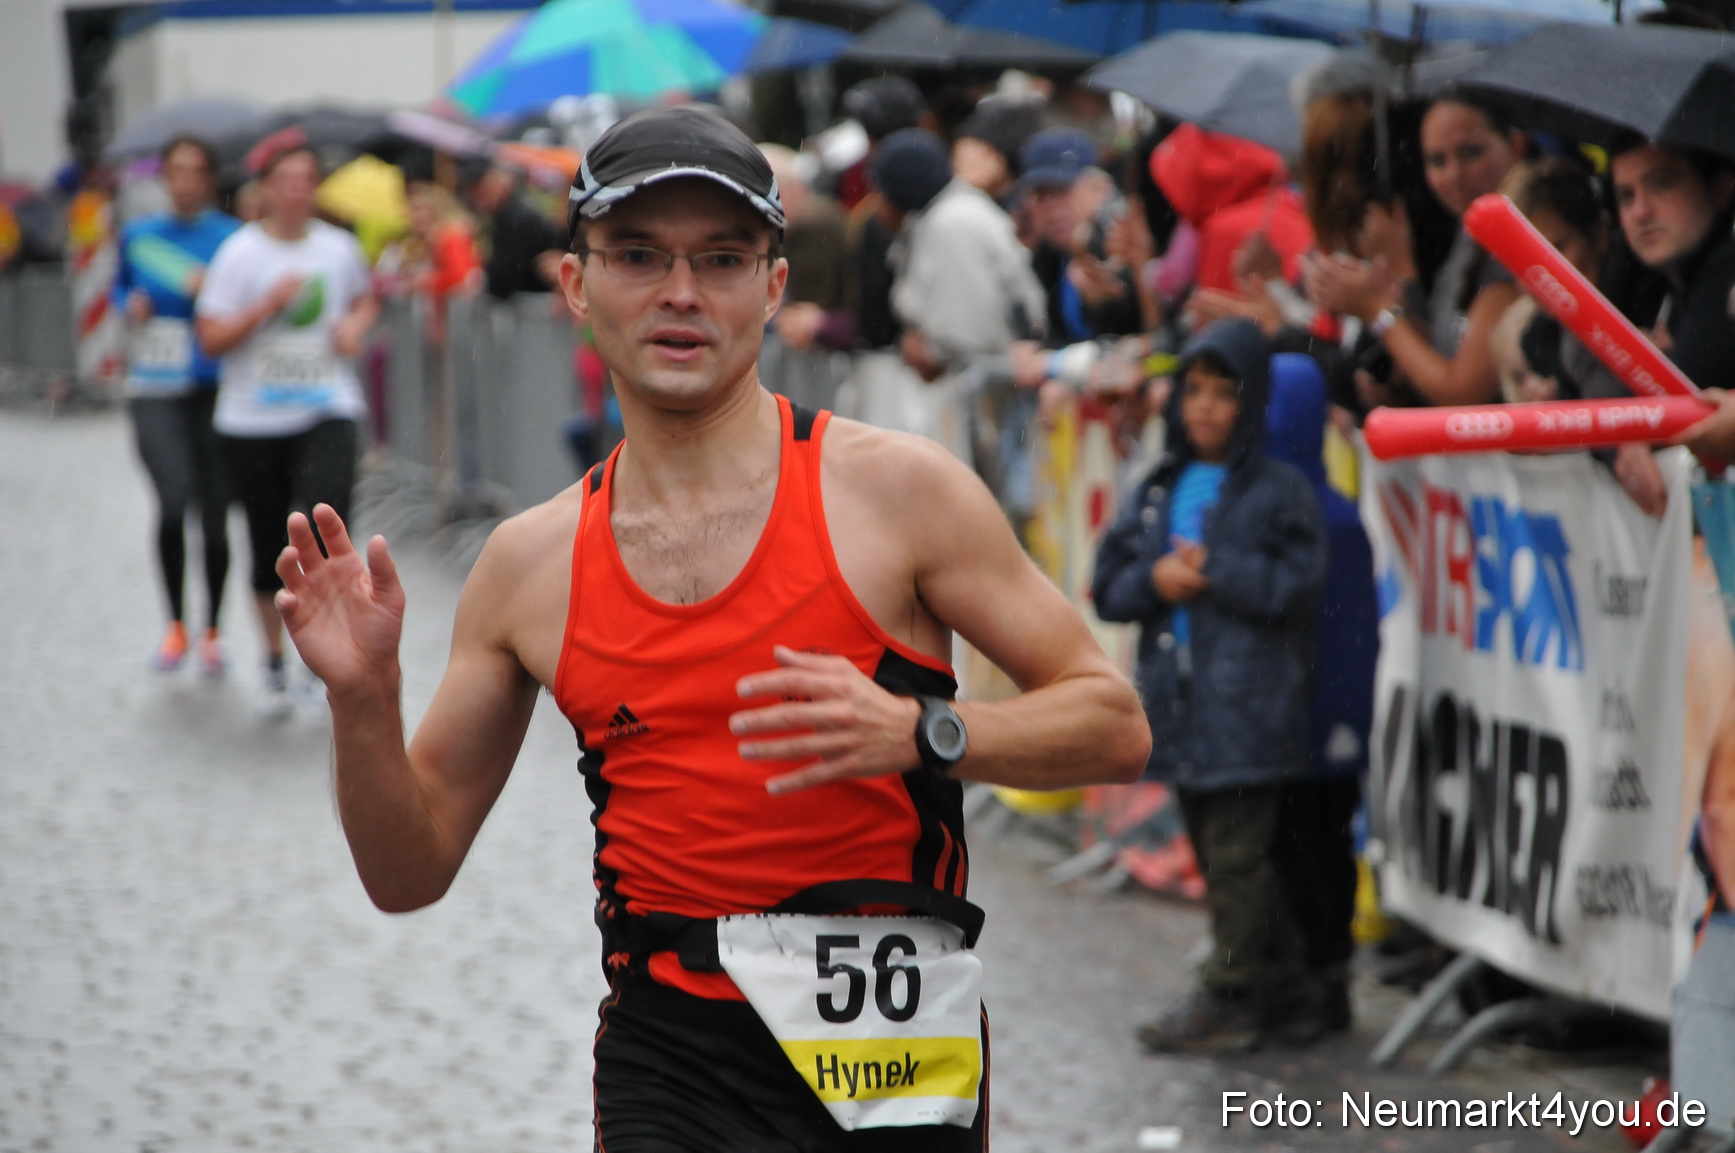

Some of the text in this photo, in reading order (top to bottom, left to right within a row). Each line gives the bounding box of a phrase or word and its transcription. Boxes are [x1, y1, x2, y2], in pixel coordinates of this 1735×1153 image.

[1597, 404, 1665, 430] Audi
[815, 934, 921, 1023] 56
[815, 1052, 920, 1098] Hynek
